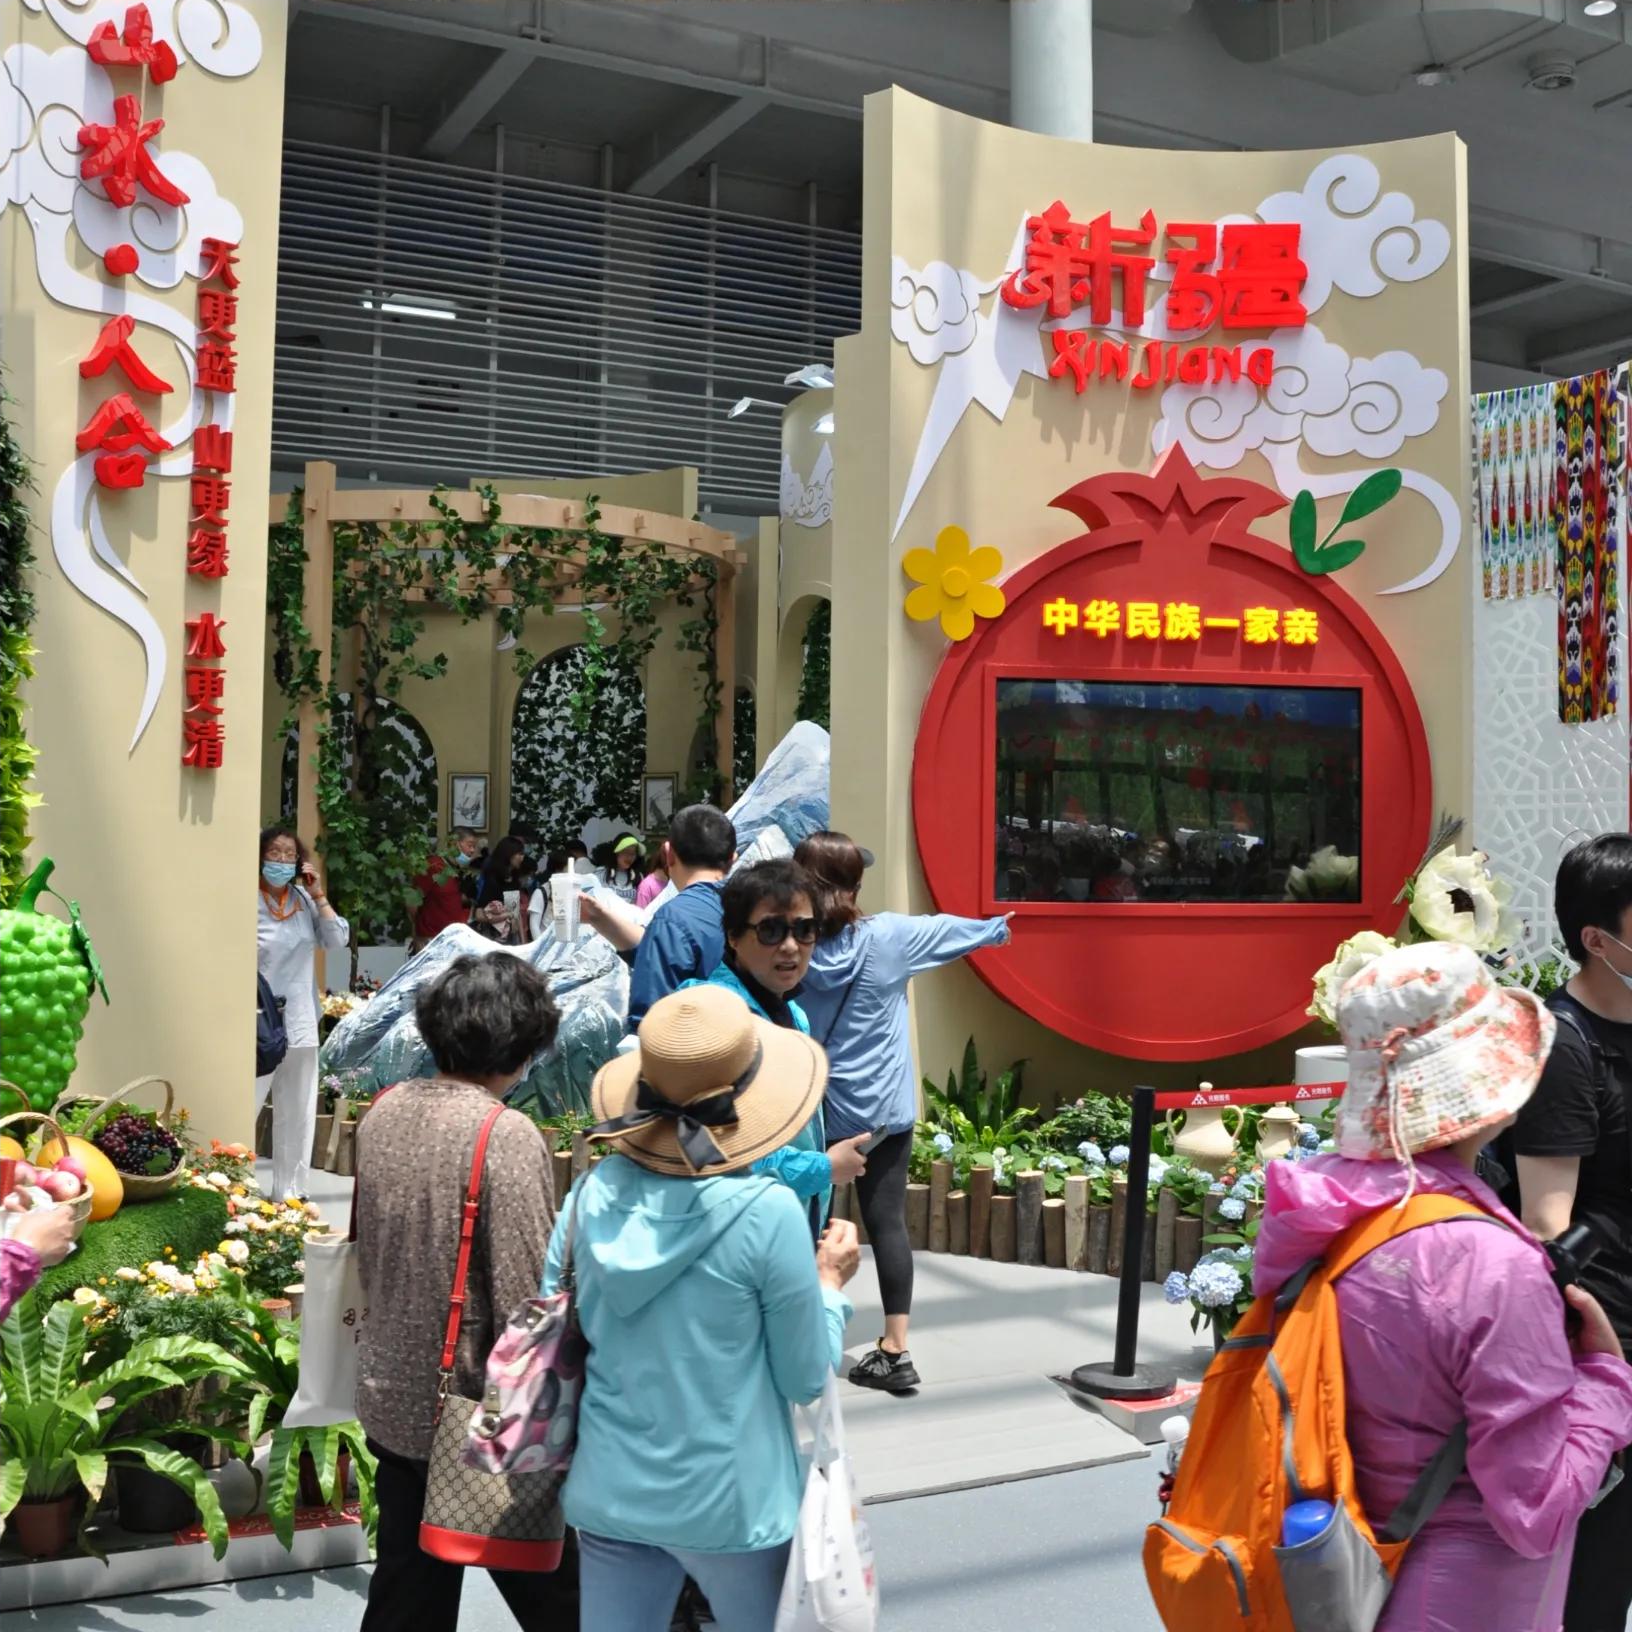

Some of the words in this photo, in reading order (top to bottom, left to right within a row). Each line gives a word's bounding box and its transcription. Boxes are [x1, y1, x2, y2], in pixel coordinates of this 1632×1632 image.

[192, 236, 241, 394] 天更蓝
[999, 199, 1309, 329] 新疆
[185, 423, 234, 580] 山更绿
[180, 610, 228, 769] 水更清
[1042, 596, 1320, 645] 中华民族一家亲
